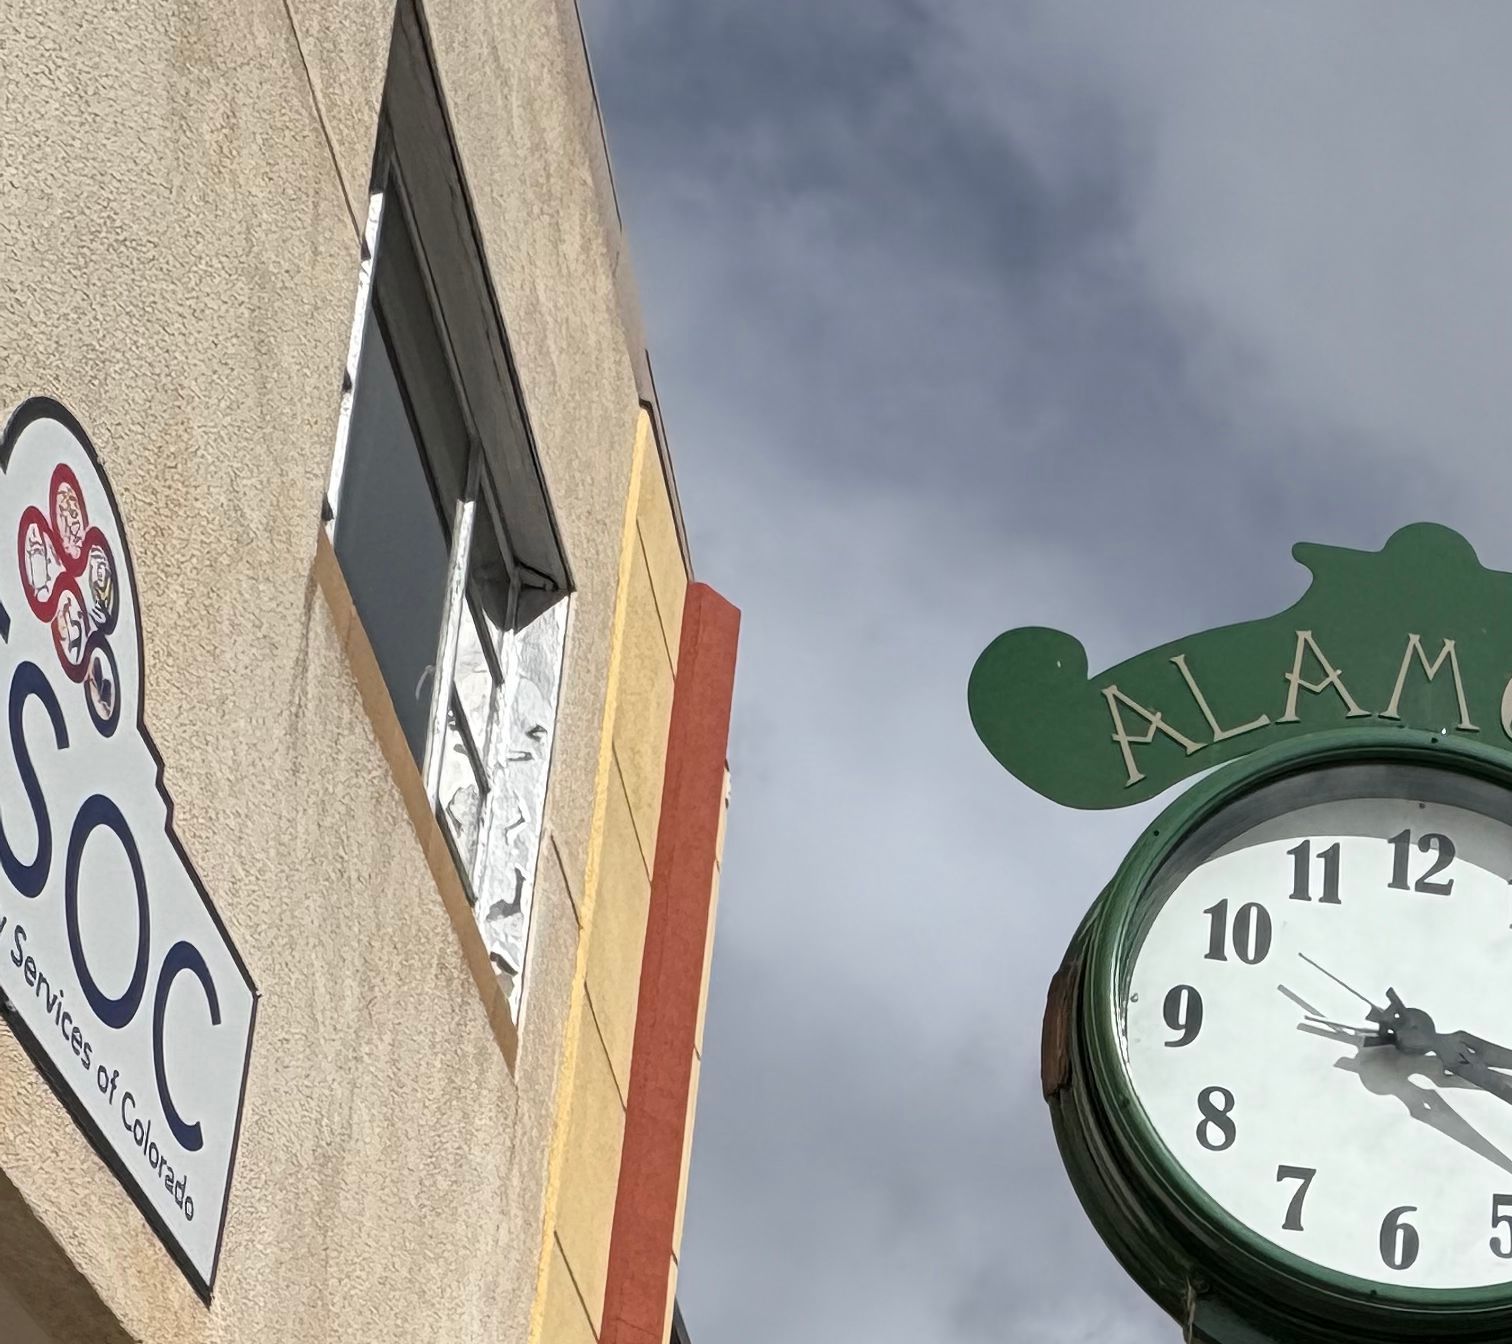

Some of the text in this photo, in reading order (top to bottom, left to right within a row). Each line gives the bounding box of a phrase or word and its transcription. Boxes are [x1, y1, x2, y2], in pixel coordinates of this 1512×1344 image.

[0, 598, 222, 1152] SOC
[1287, 839, 1341, 904] 11
[1386, 829, 1456, 896] 12
[1203, 899, 1271, 966] 10
[1162, 984, 1203, 1048] 9
[10, 924, 194, 1222] Services of Colorado
[1196, 1086, 1236, 1149] 8
[1276, 1164, 1316, 1232] 7
[1379, 1206, 1419, 1270] 6
